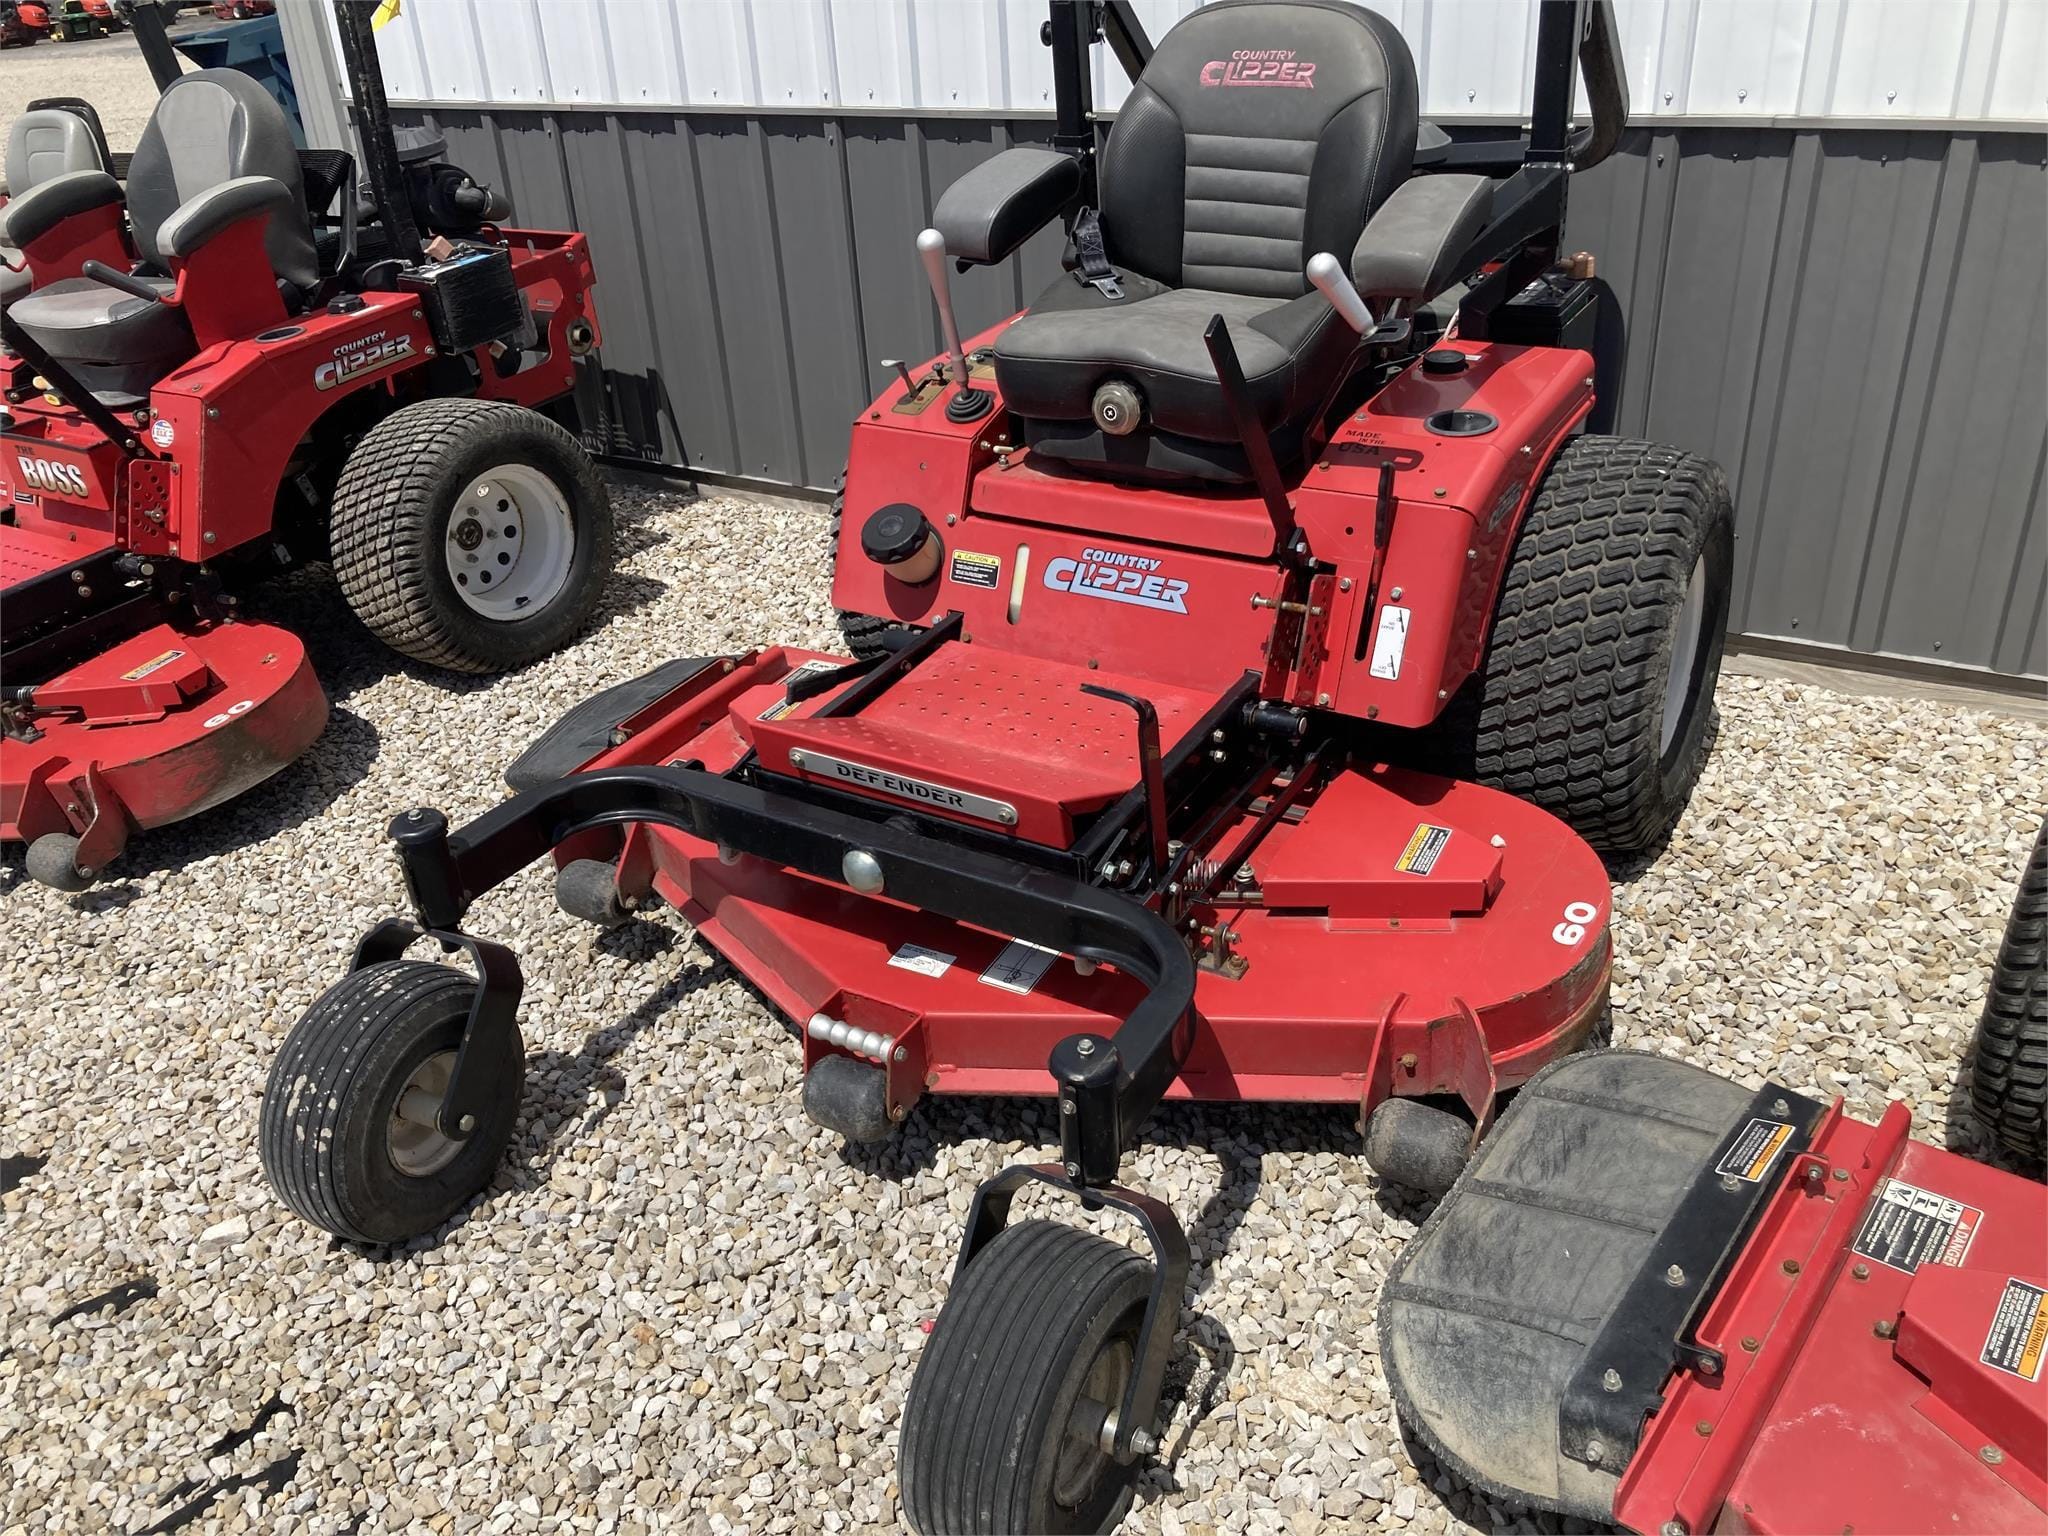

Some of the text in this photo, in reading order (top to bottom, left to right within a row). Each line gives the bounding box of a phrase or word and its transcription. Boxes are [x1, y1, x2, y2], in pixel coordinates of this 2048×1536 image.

[1232, 50, 1296, 60] COUNTRY
[1200, 60, 1316, 88] CLIPPER
[333, 330, 386, 357] COUNTRY
[314, 334, 417, 391] CLIPPER
[1338, 442, 1380, 455] USA
[1345, 430, 1381, 439] MADE
[15, 445, 34, 455] THE
[17, 456, 89, 498] BOSS
[1081, 547, 1163, 571] COUNTRY
[1043, 556, 1190, 615] CLIPPER
[203, 700, 254, 728] 60
[836, 763, 964, 808] DEFENDER
[1552, 901, 1597, 946] 60
[2026, 1320, 2048, 1358] WARNING
